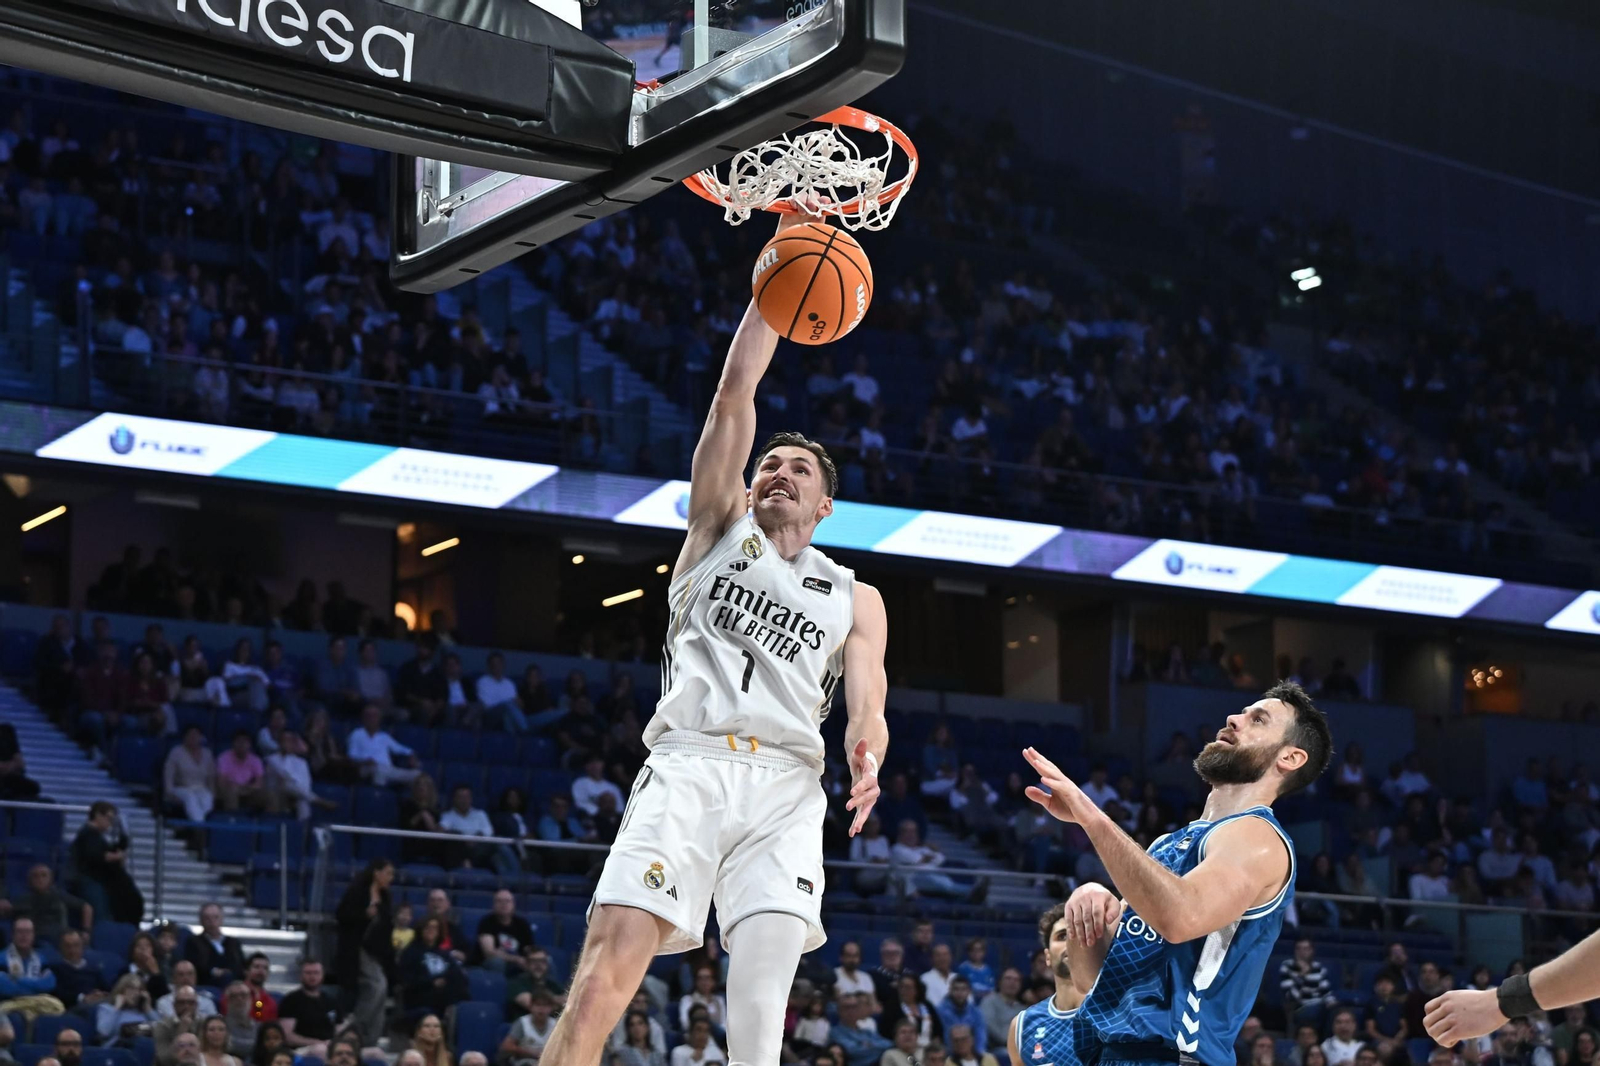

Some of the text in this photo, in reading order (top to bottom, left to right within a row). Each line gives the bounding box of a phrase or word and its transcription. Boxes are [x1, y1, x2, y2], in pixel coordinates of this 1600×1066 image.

[177, 0, 414, 82] esa
[809, 320, 826, 340] acb
[708, 575, 826, 650] Emirates
[713, 606, 802, 663] FLY BETTER
[740, 649, 756, 694] 7
[799, 883, 811, 892] acb
